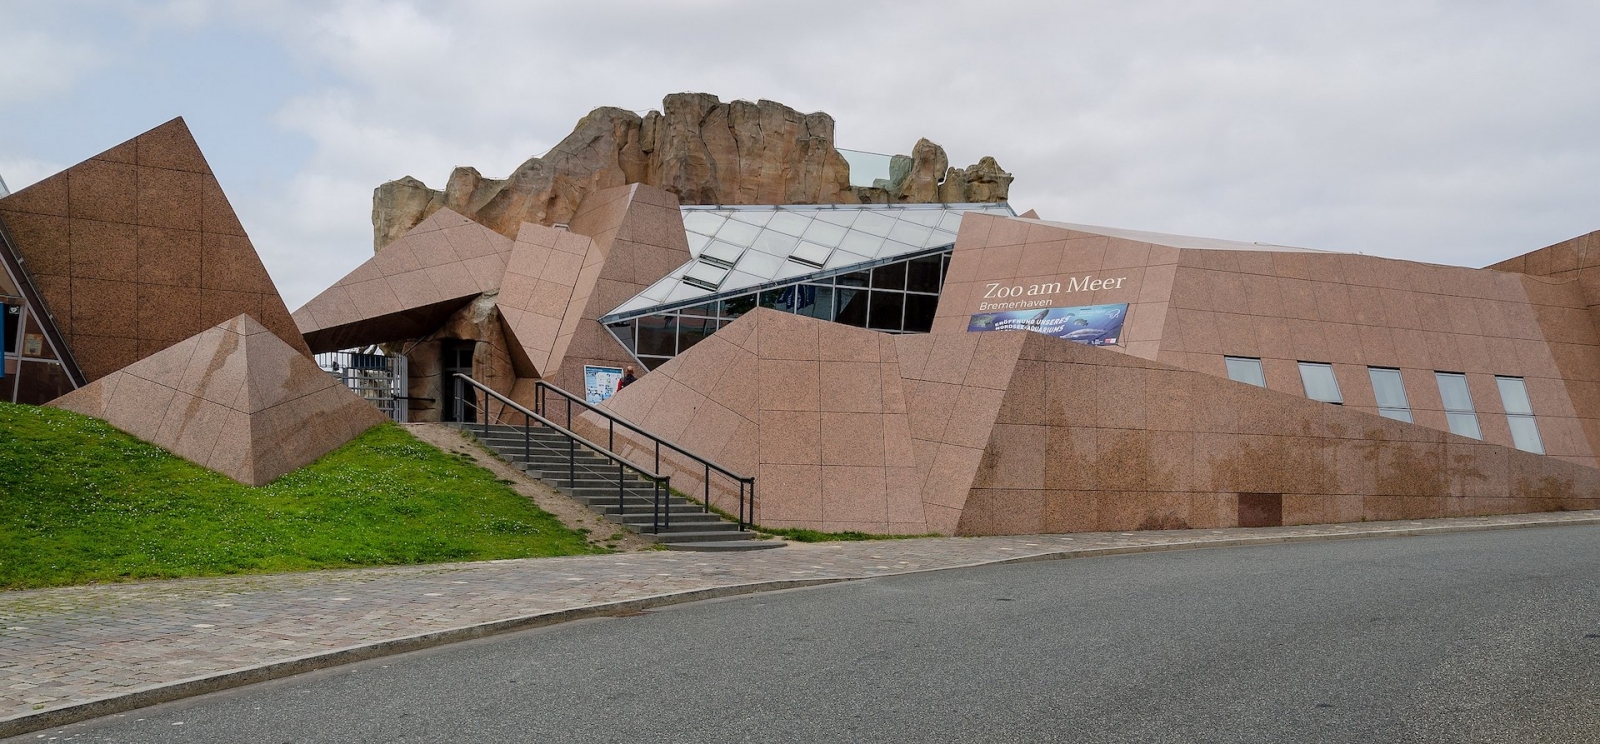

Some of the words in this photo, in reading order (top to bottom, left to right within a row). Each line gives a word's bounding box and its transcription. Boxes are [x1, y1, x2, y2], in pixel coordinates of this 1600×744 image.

[983, 283, 1023, 299] Zoo
[1027, 282, 1061, 296] am
[1066, 276, 1127, 293] Meer
[979, 299, 1053, 311] Bremerhaven
[994, 318, 1035, 327] ERÖFFNUNG
[1036, 315, 1071, 325] UNSERES
